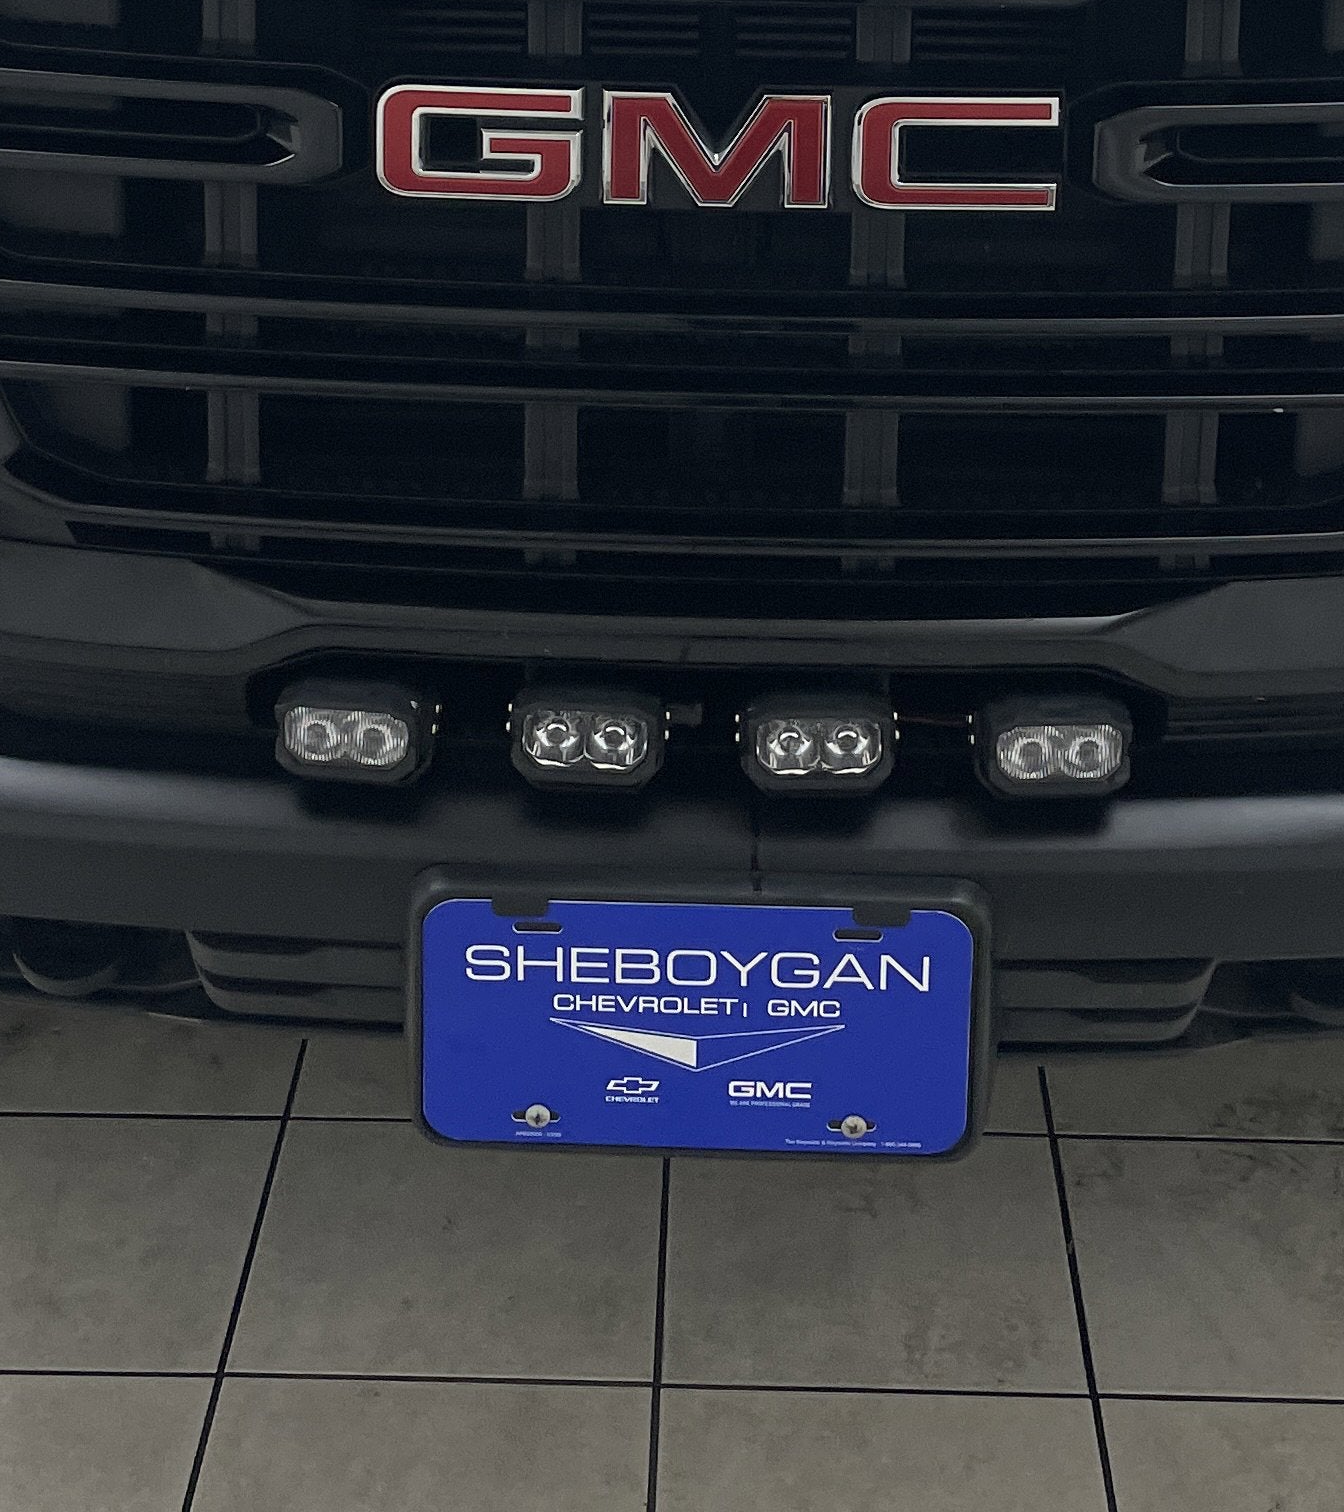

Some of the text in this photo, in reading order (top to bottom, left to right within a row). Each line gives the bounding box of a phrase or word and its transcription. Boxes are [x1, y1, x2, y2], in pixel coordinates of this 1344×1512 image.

[374, 83, 1063, 214] GMC
[464, 943, 932, 993] SHEBOYGAN
[552, 993, 842, 1018] CHEVROLET GMC
[604, 1095, 660, 1104] CHEVROLET
[728, 1081, 812, 1099] GMC
